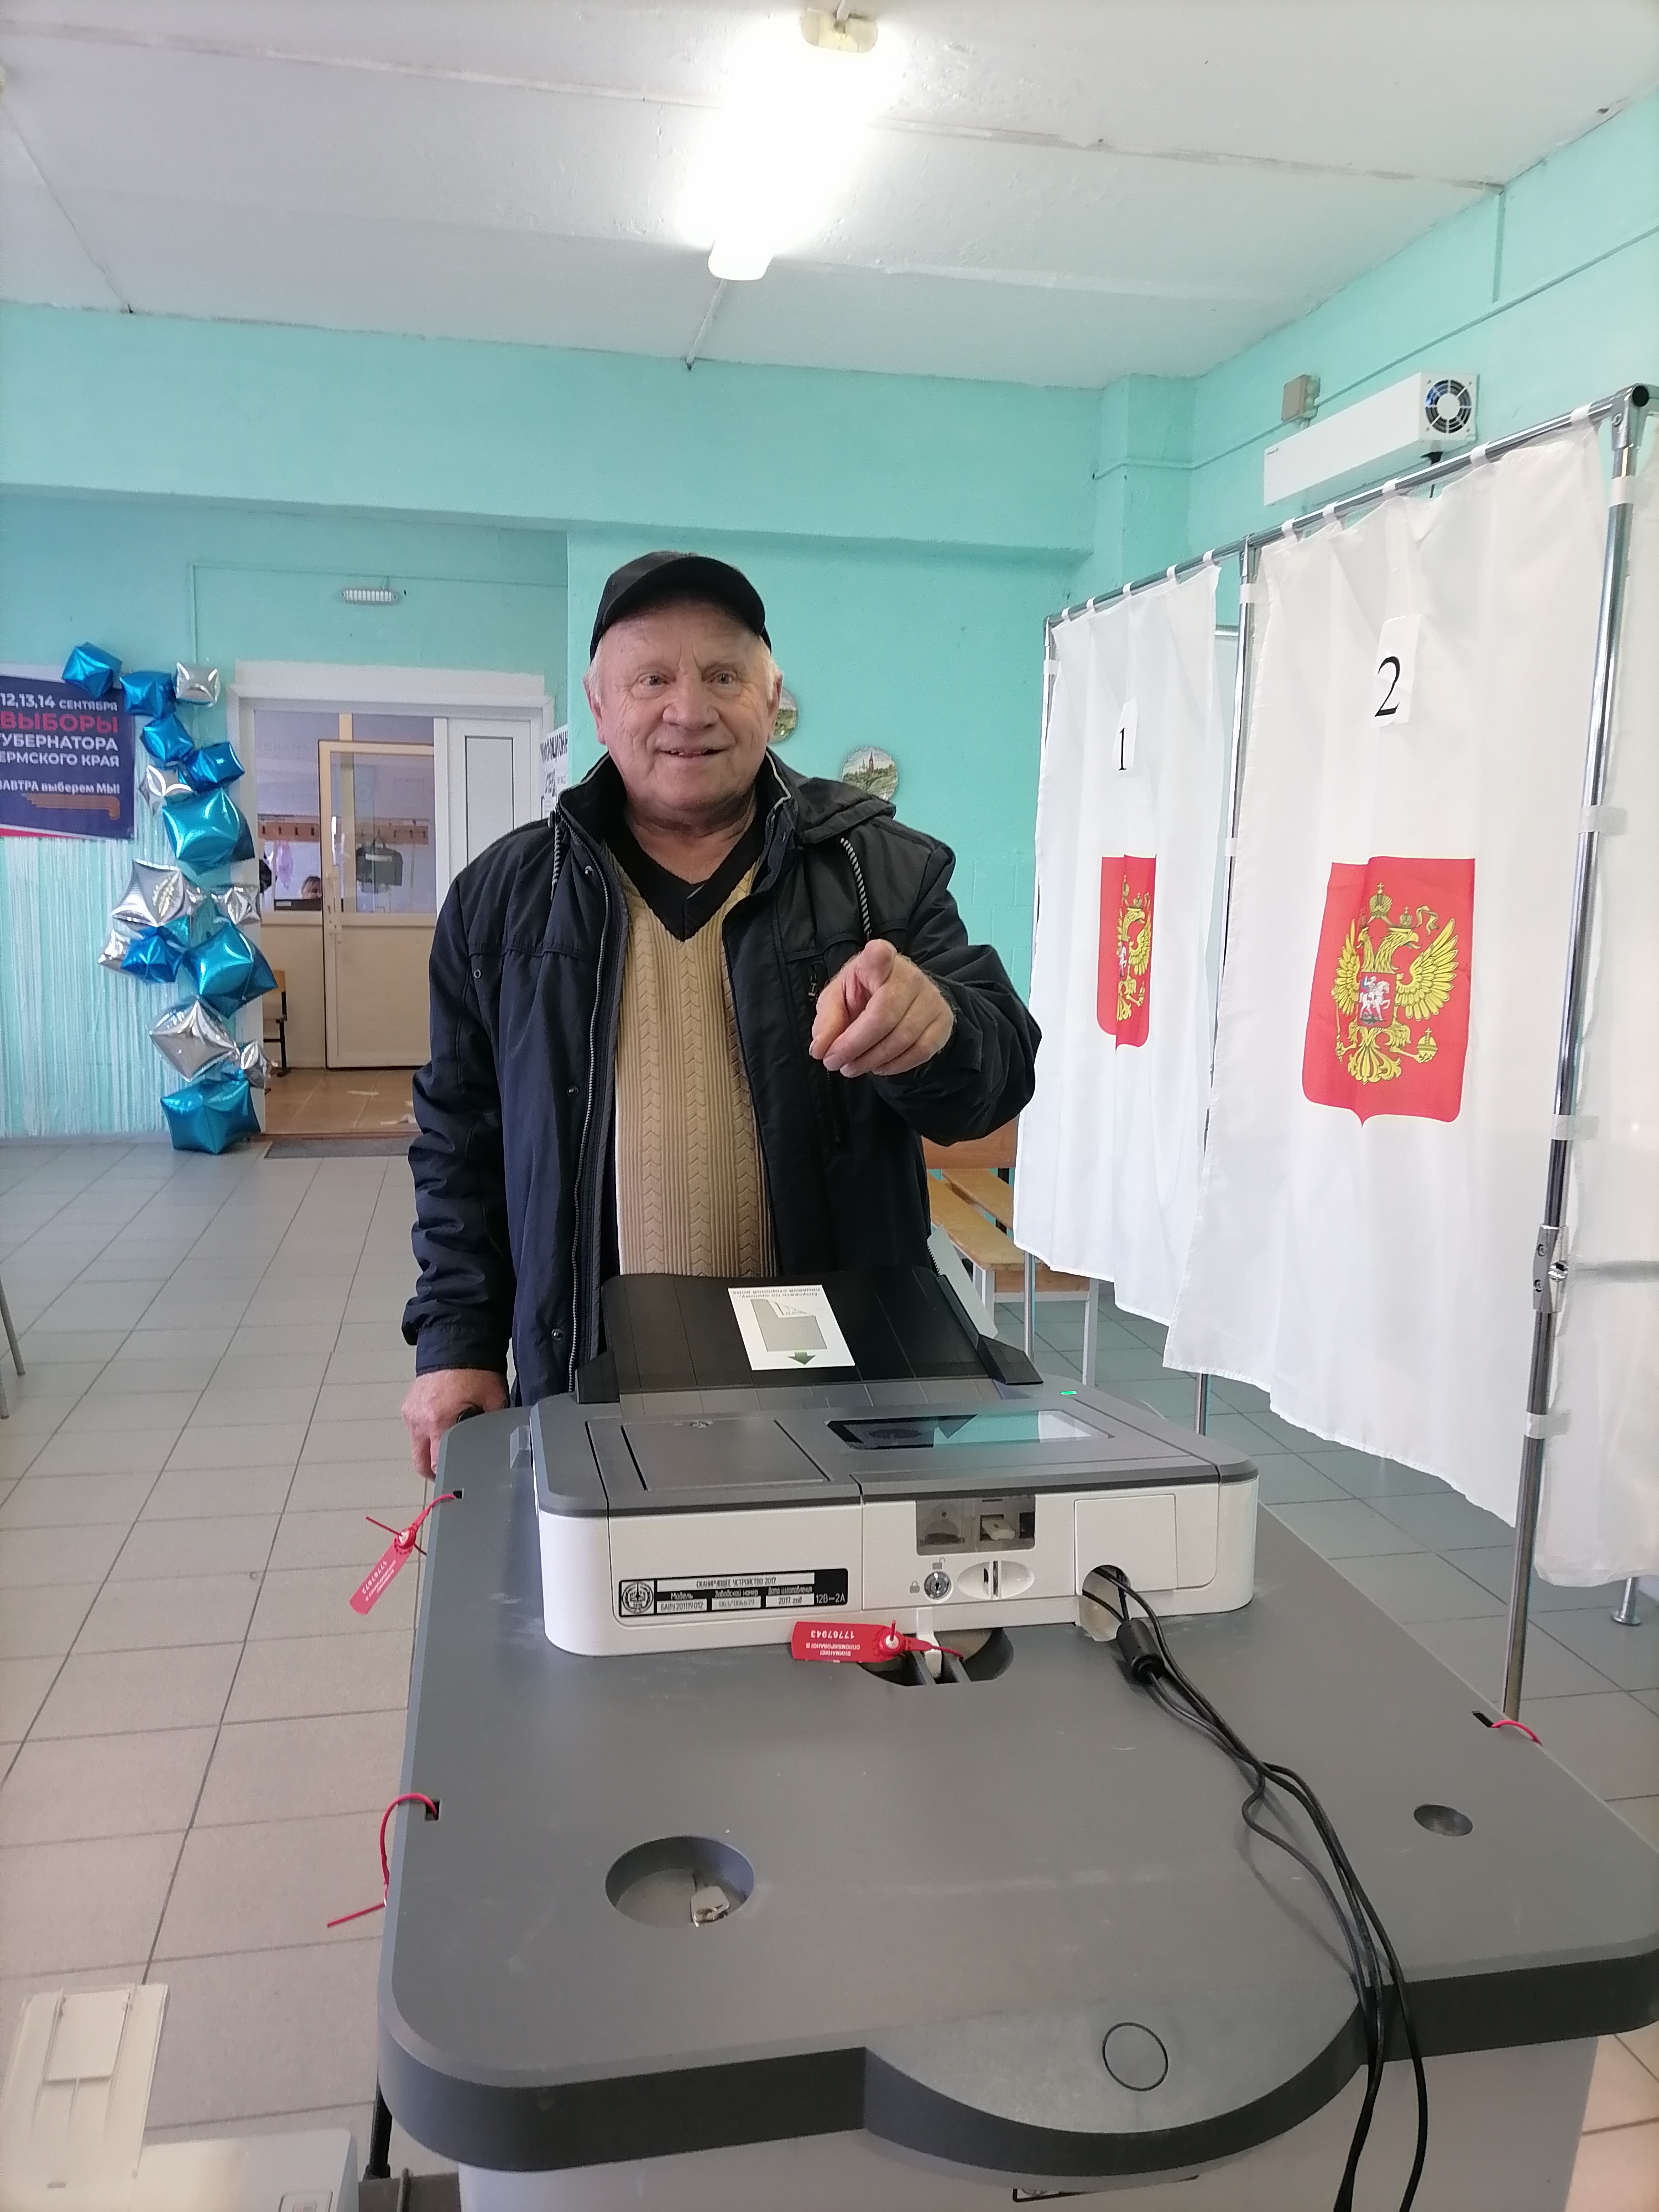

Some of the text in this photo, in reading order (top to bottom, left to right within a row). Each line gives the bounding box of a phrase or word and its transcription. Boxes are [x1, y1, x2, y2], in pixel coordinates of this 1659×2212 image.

[1374, 656, 1400, 717] 2
[0, 692, 118, 712] 12,13,14 СЕНТЯБРЯ
[1, 711, 118, 733] ВЫБОРЫ
[0, 733, 118, 751] УБЕРНАТОРА
[1118, 727, 1127, 771] 1
[81, 754, 119, 768] КРАЯ
[41, 781, 94, 795] выберем
[96, 782, 120, 794] МЫ!
[764, 1577, 776, 1585] 2017
[671, 1592, 693, 1600] Модель
[778, 1597, 791, 1605] 2017
